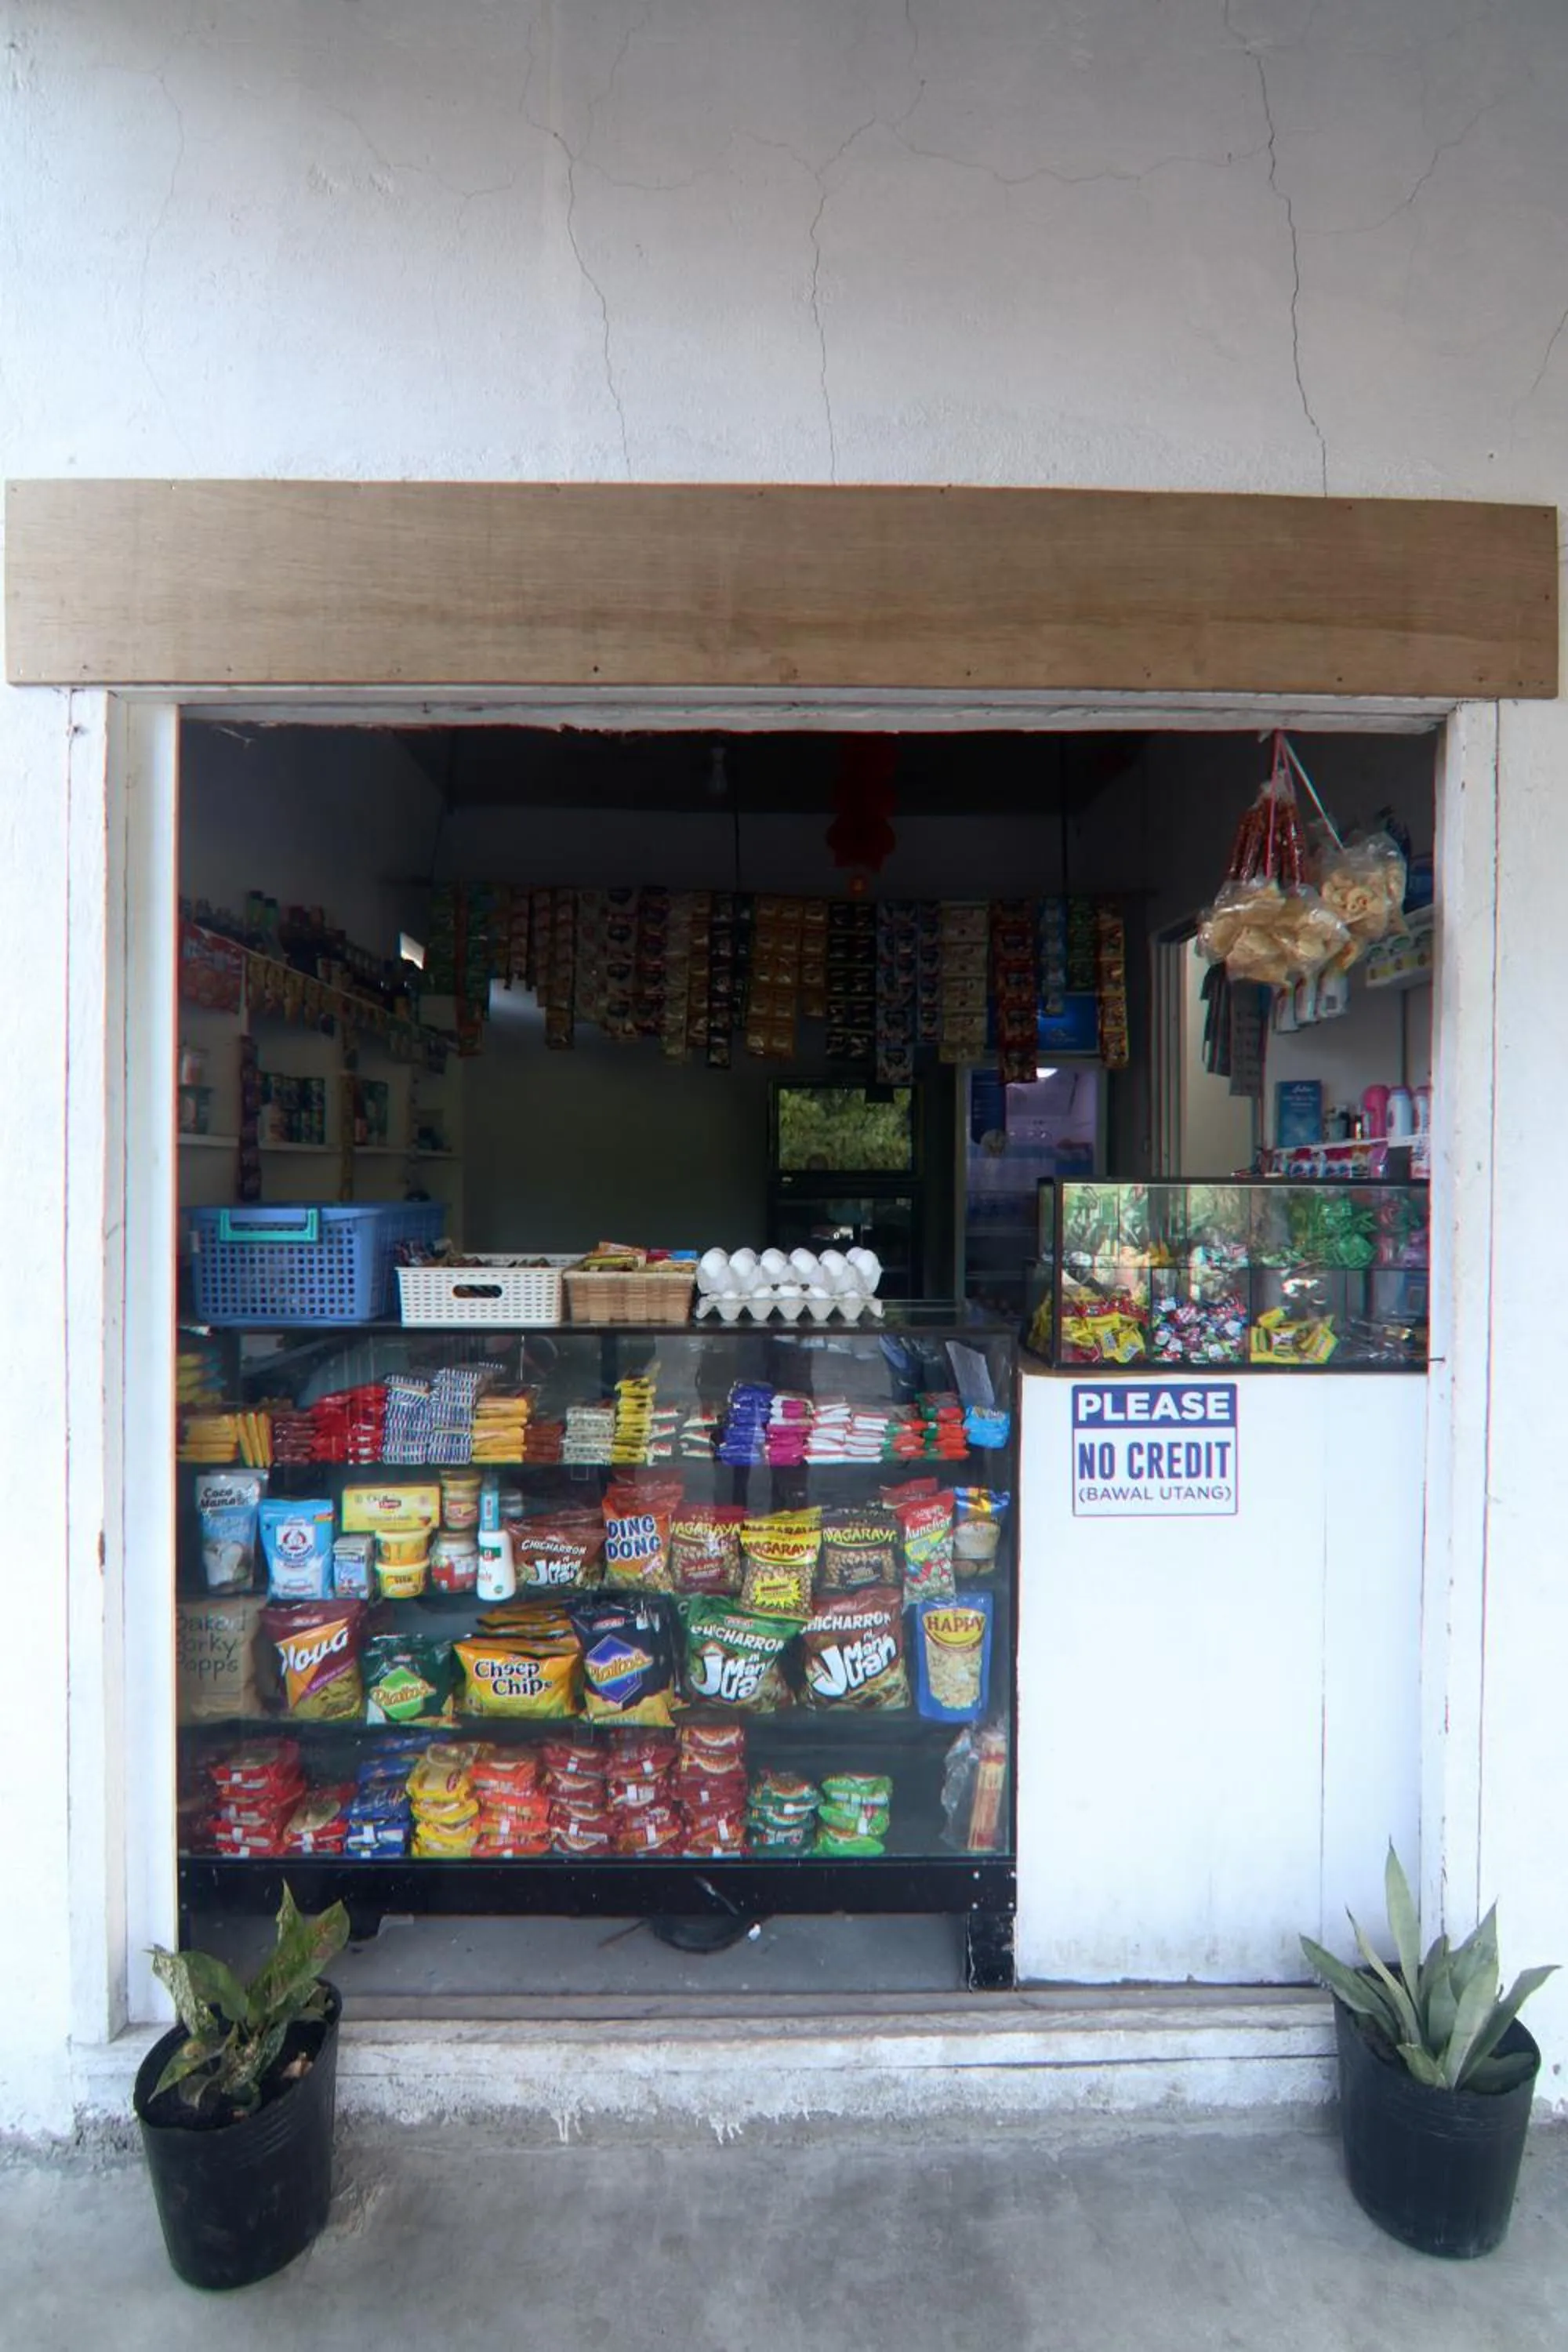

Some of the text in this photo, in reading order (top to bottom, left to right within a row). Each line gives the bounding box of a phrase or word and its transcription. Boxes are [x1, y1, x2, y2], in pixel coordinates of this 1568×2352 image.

[1078, 1391, 1230, 1421] PLEASE
[1078, 1441, 1232, 1480] NO CREDIT
[1078, 1485, 1232, 1503] (BAWAL UTANG)
[607, 1515, 655, 1539] DING
[606, 1537, 661, 1559] DONG
[927, 1614, 985, 1632] HAPPY
[492, 1678, 553, 1696] Chips
